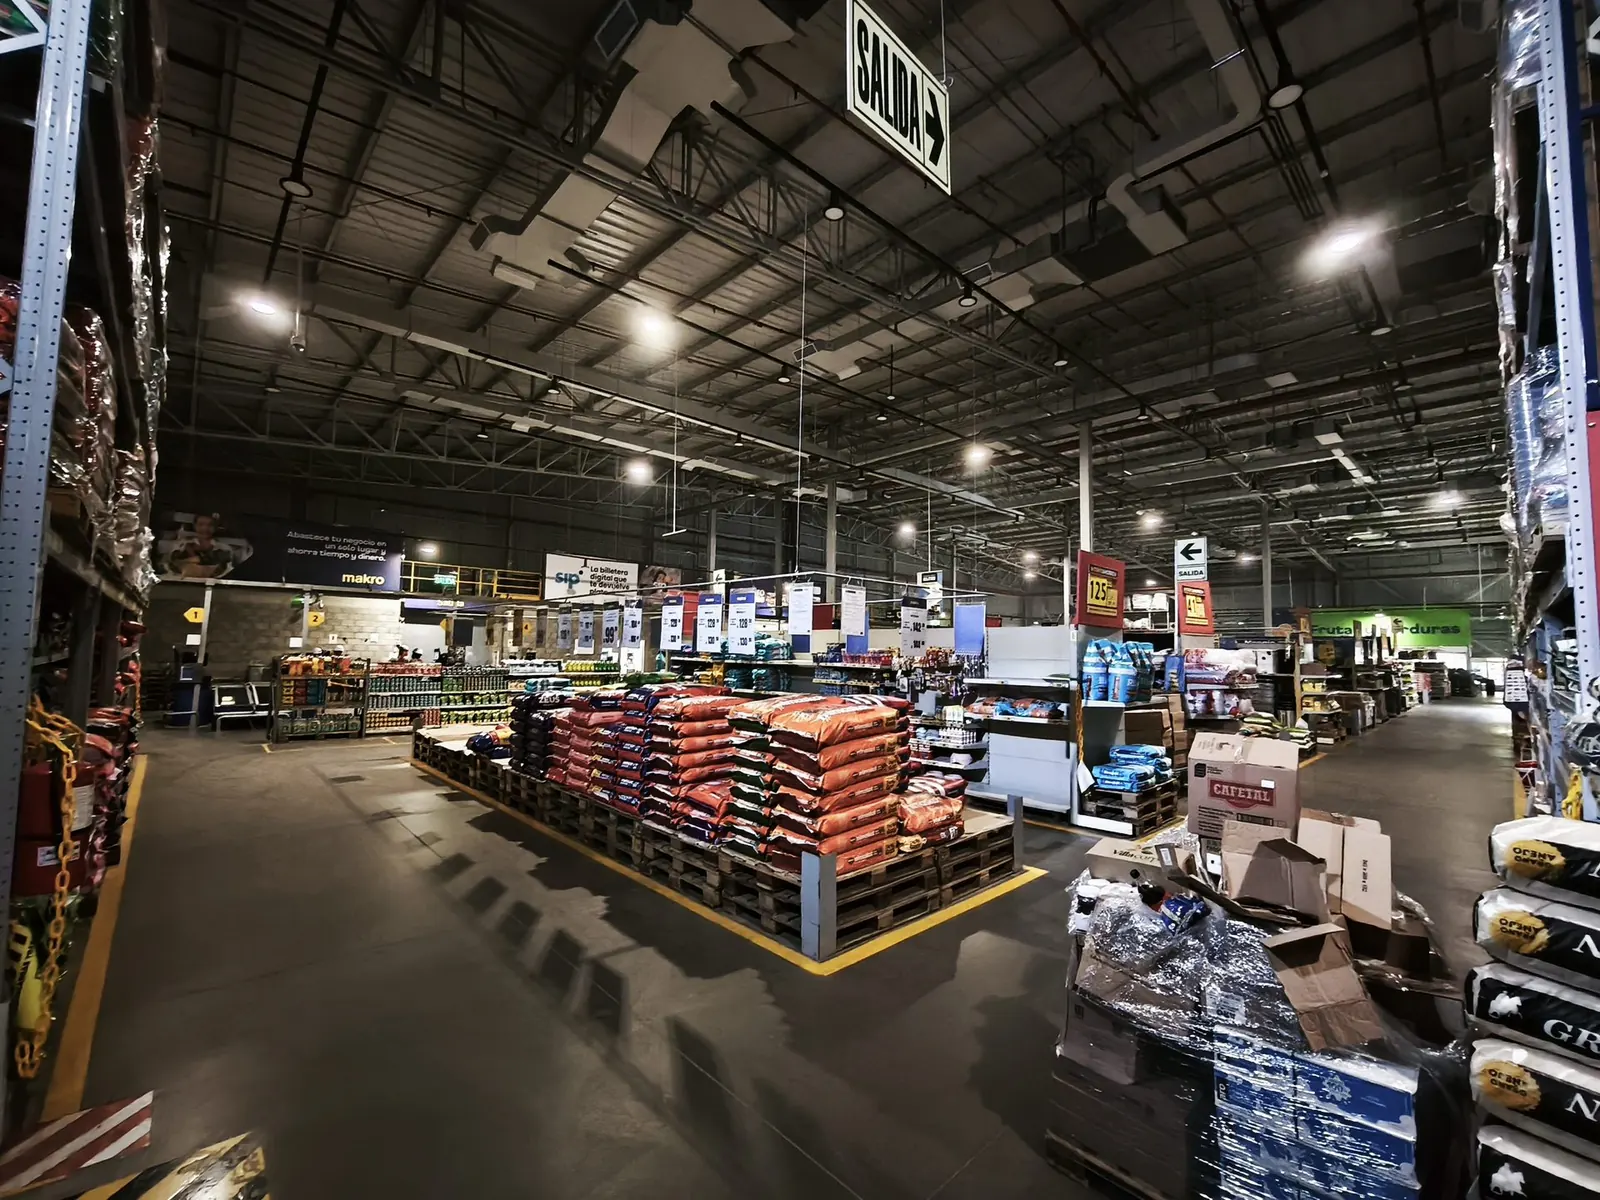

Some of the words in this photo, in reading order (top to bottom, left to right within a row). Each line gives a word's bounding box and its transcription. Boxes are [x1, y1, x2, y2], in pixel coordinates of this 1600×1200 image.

[857, 18, 922, 152] SALIDA
[287, 531, 330, 541] Abastece
[343, 538, 375, 546] negocio
[287, 547, 318, 555] ahorra
[319, 550, 350, 559] tiempo
[350, 553, 357, 561] y
[357, 553, 386, 562] dinero.
[357, 546, 379, 554] lugar
[590, 565, 598, 573] La
[599, 566, 629, 576] billetera
[341, 573, 385, 585] makro
[555, 572, 580, 593] sip
[589, 573, 613, 582] digital
[613, 576, 628, 584] que
[589, 580, 598, 588] te
[598, 580, 630, 590] devuelve
[1090, 577, 1107, 601] 125
[193, 611, 199, 619] 1
[1312, 624, 1355, 635] Fruta
[538, 695, 560, 704] ZEUS
[1213, 783, 1271, 802] CAFETAL
